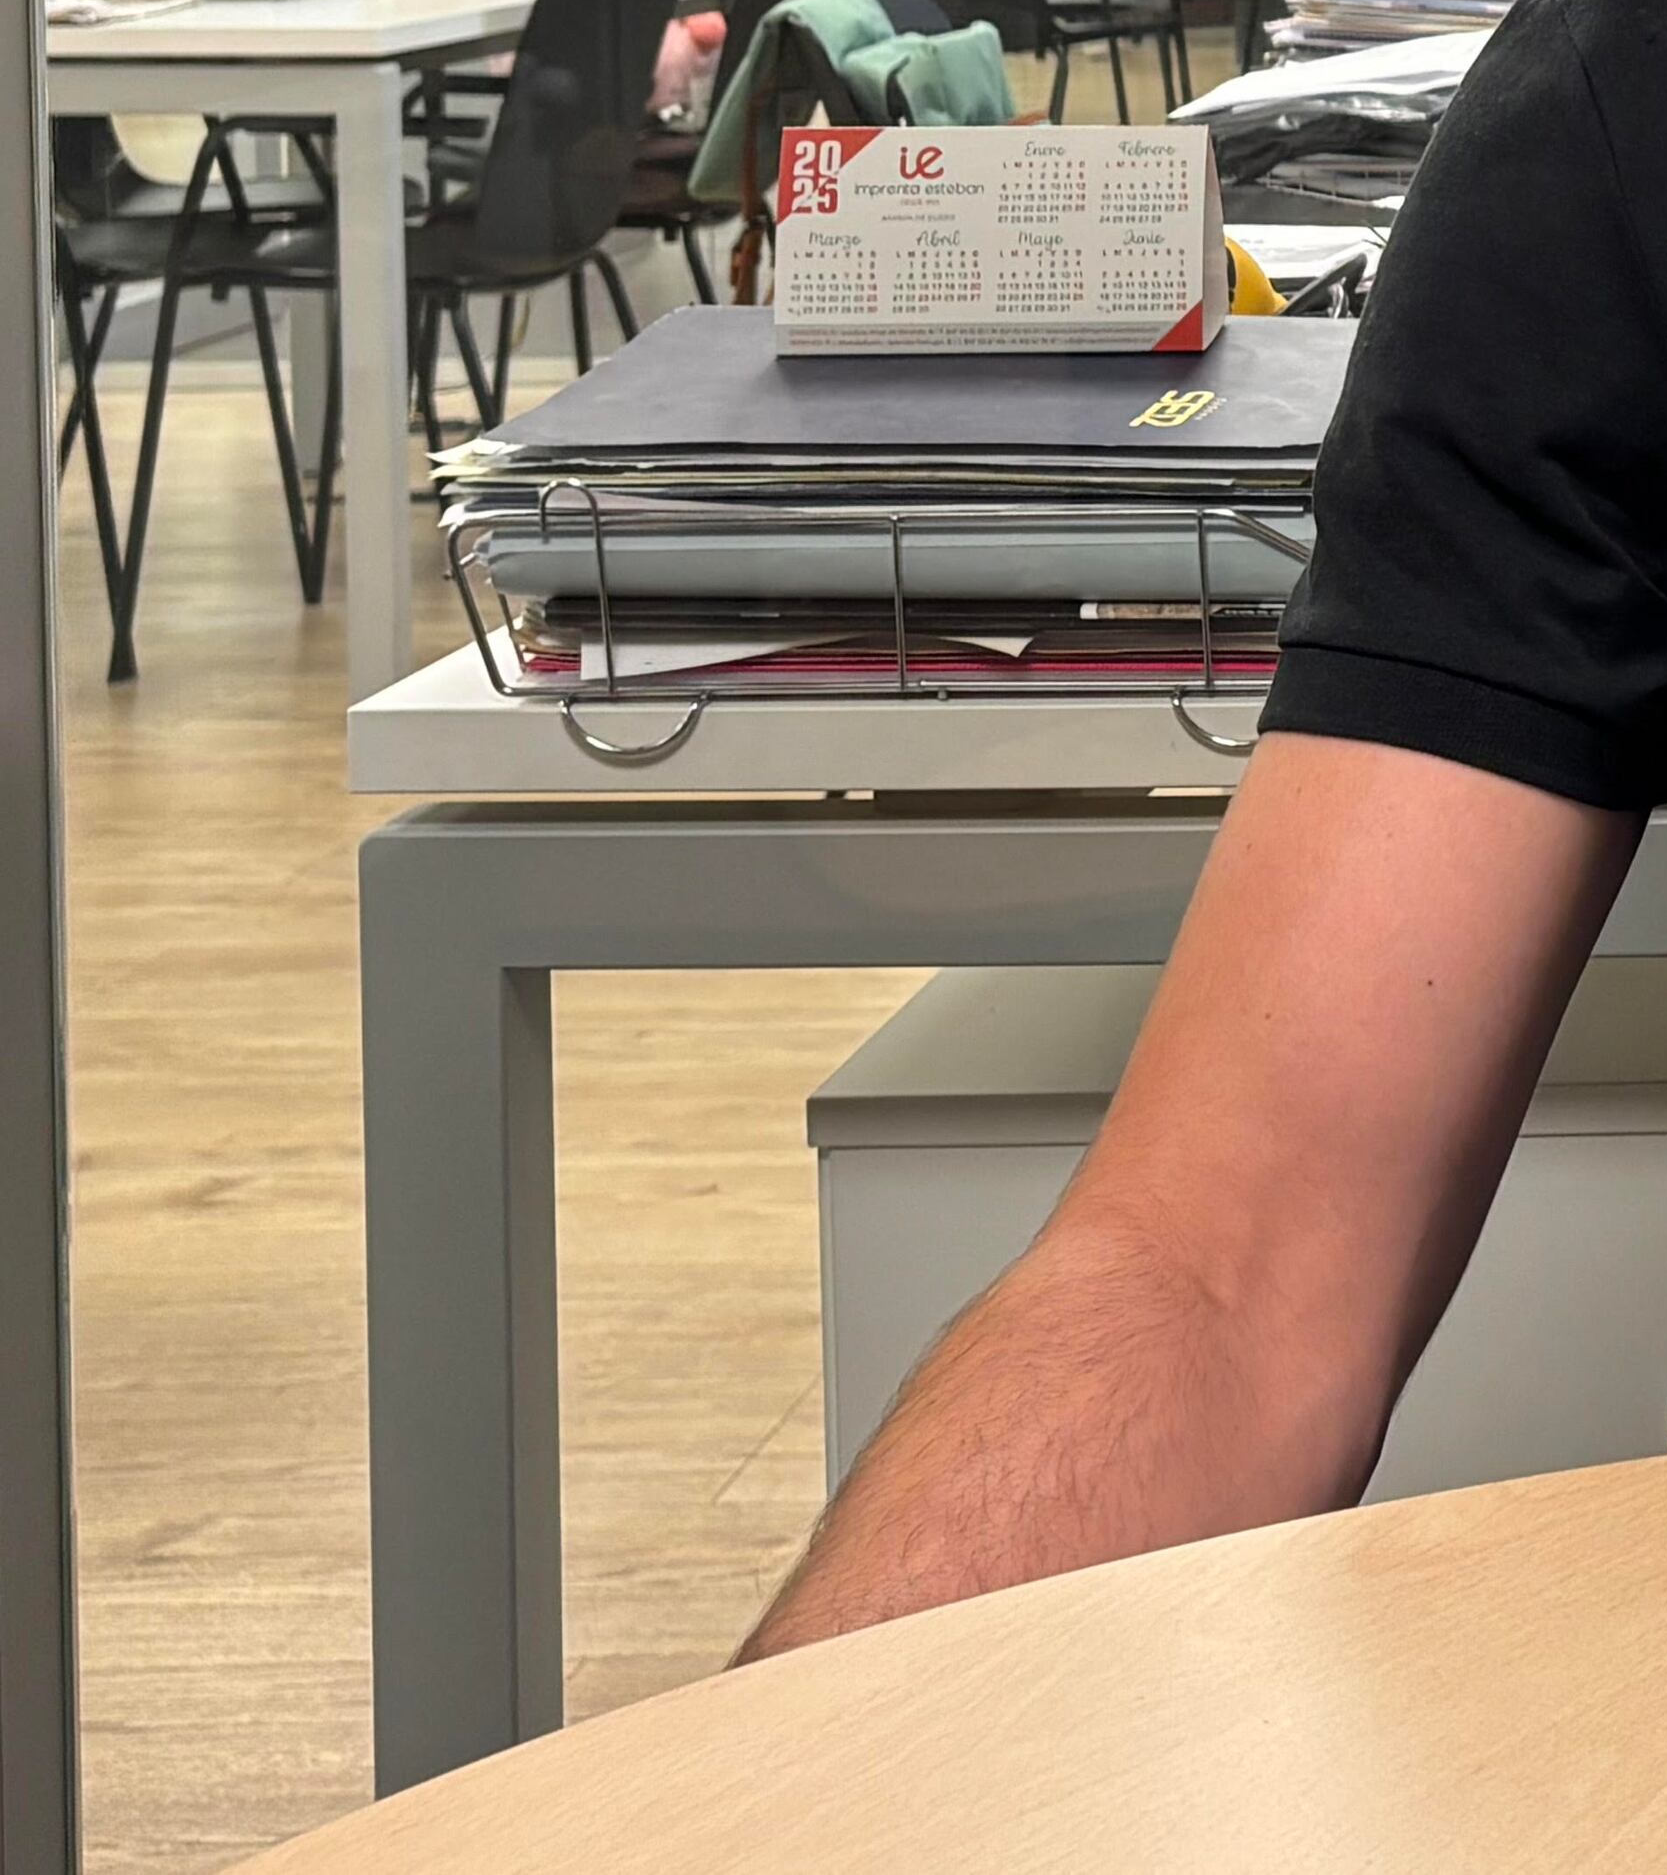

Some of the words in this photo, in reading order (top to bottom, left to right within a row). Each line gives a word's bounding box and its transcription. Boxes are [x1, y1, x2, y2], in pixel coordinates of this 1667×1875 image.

[1025, 141, 1066, 157] Enero
[1118, 140, 1176, 156] Febrero
[793, 140, 841, 176] 20
[900, 146, 944, 180] ie
[792, 177, 839, 214] 25
[854, 183, 920, 198] imprenta
[925, 183, 985, 195] esteban
[809, 232, 861, 250] Marzo
[916, 230, 960, 246] Abril
[1018, 231, 1063, 251] Mayo
[1123, 229, 1166, 245] Junio
